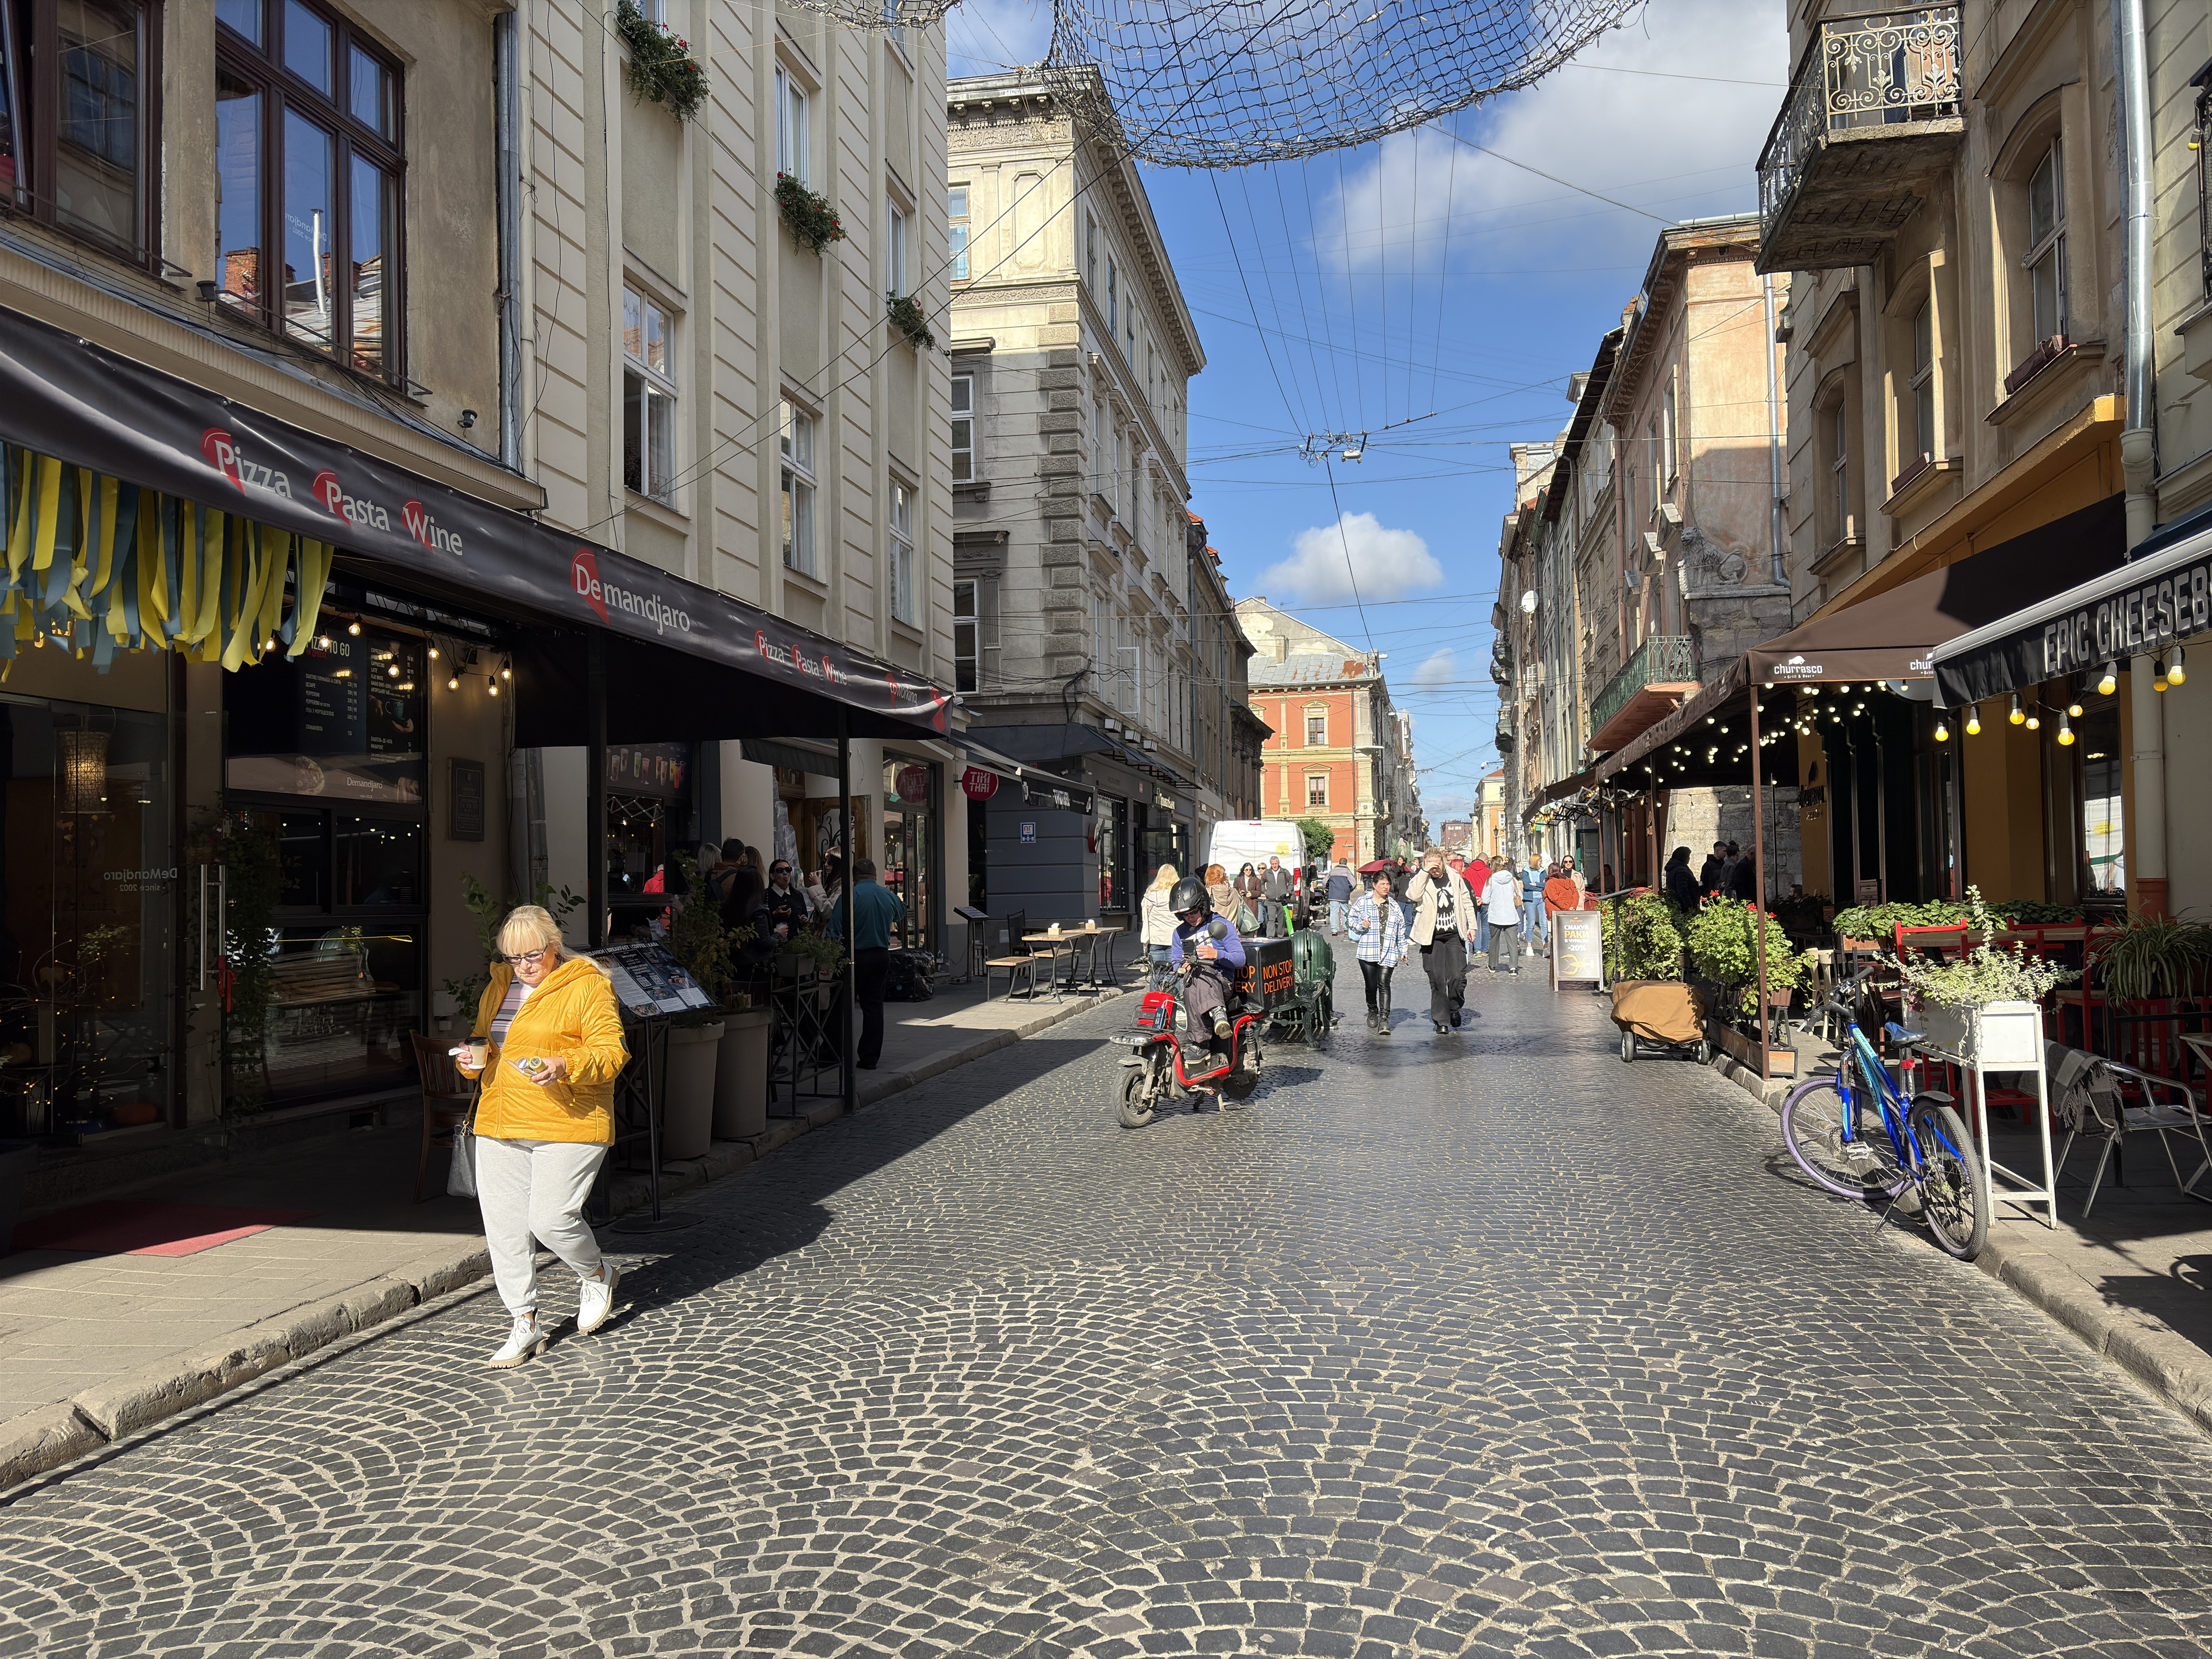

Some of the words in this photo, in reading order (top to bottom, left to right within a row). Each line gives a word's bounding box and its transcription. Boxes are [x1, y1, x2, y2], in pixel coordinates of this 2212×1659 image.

[214, 440, 293, 499] Pizza
[325, 480, 392, 532] Pasta
[403, 507, 463, 556] Wine
[575, 563, 691, 635] Demandjaro
[2044, 611, 2089, 674] EPIC
[2096, 563, 2212, 655] CHEESEB
[330, 640, 338, 655] TO
[340, 642, 350, 657] GO
[758, 635, 785, 663] Pizza
[795, 650, 820, 677] Pasta
[822, 660, 847, 686] Wine
[1774, 664, 1823, 674] churrasco
[347, 777, 383, 792] Demandjaro
[970, 771, 990, 784] TIKI
[969, 782, 990, 793] THAI
[1564, 930, 1589, 938] РАКИ
[606, 945, 630, 953] BREAKFAST
[1263, 964, 1277, 980] NON
[1279, 959, 1293, 975] STOP
[1264, 974, 1293, 994] DELIVERY
